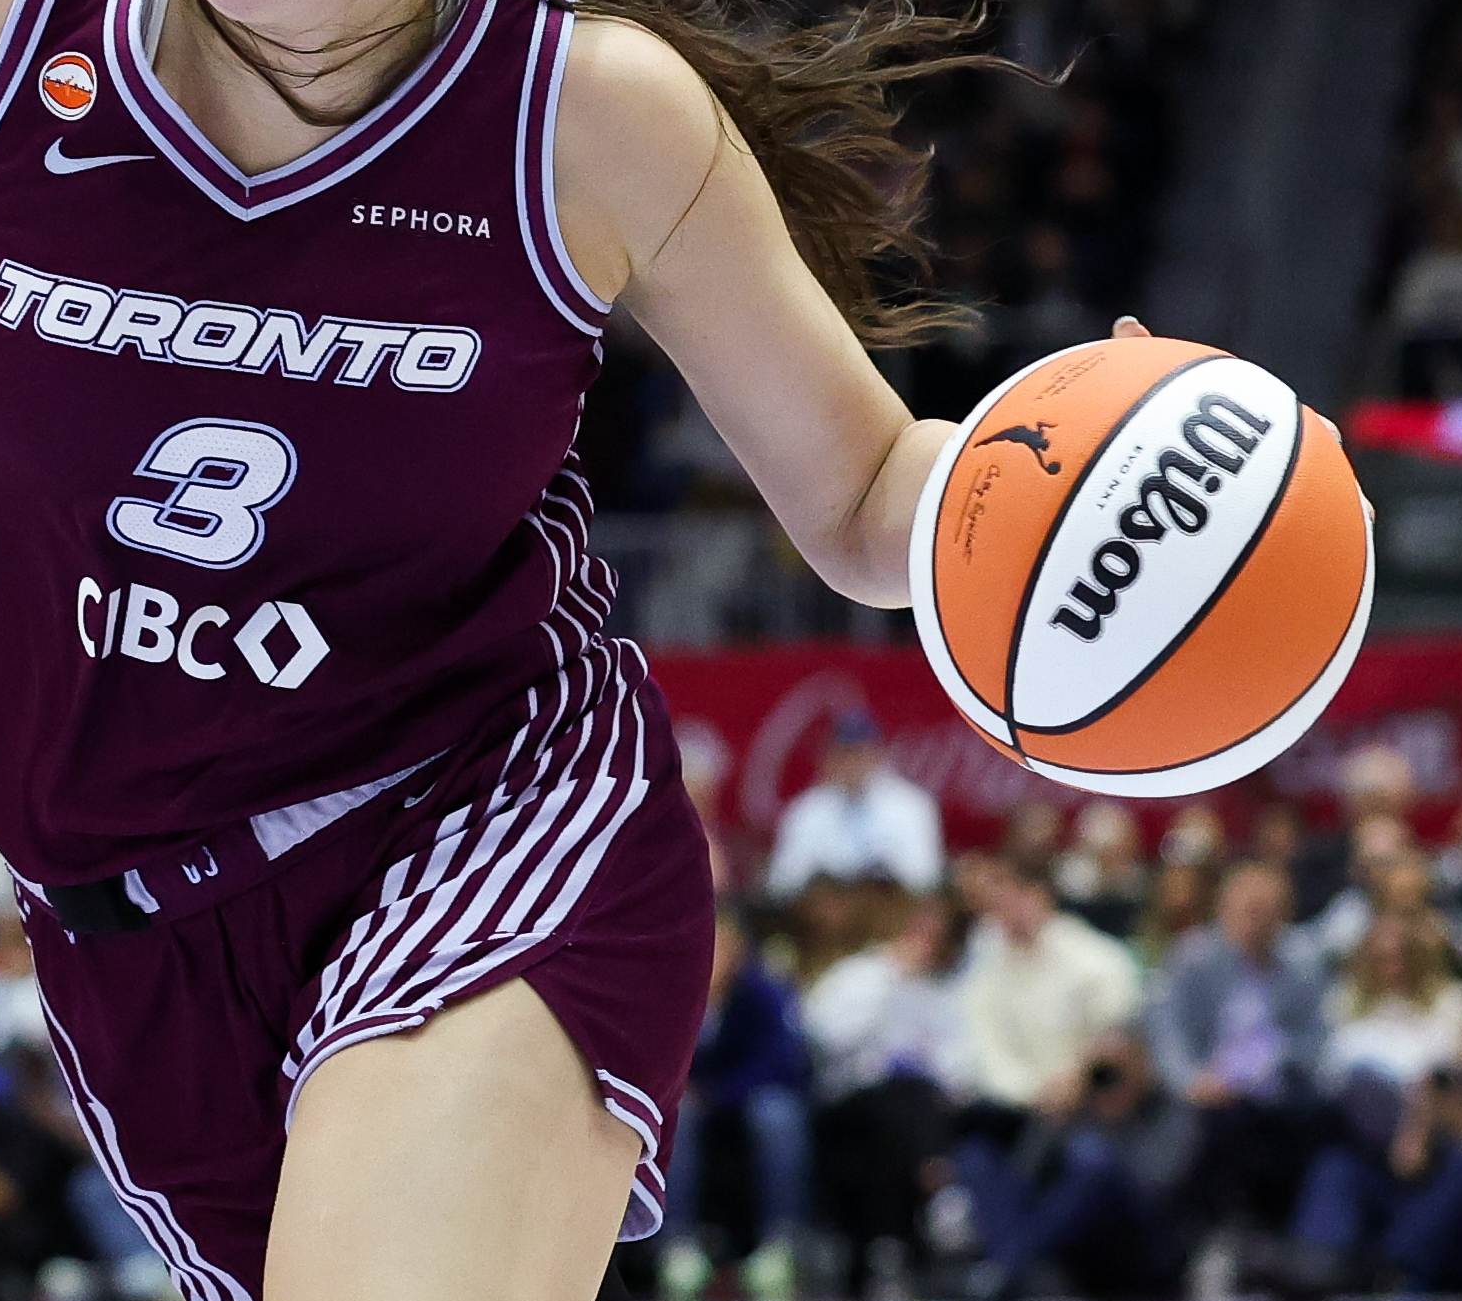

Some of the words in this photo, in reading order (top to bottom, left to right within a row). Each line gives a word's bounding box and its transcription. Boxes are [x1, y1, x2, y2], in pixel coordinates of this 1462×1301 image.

[350, 203, 492, 240] SEPHORA
[106, 416, 299, 571] 3
[1096, 478, 1121, 511] NXT
[1119, 445, 1144, 475] EVO
[1047, 390, 1272, 643] Wilson
[76, 576, 231, 681] CIBC
